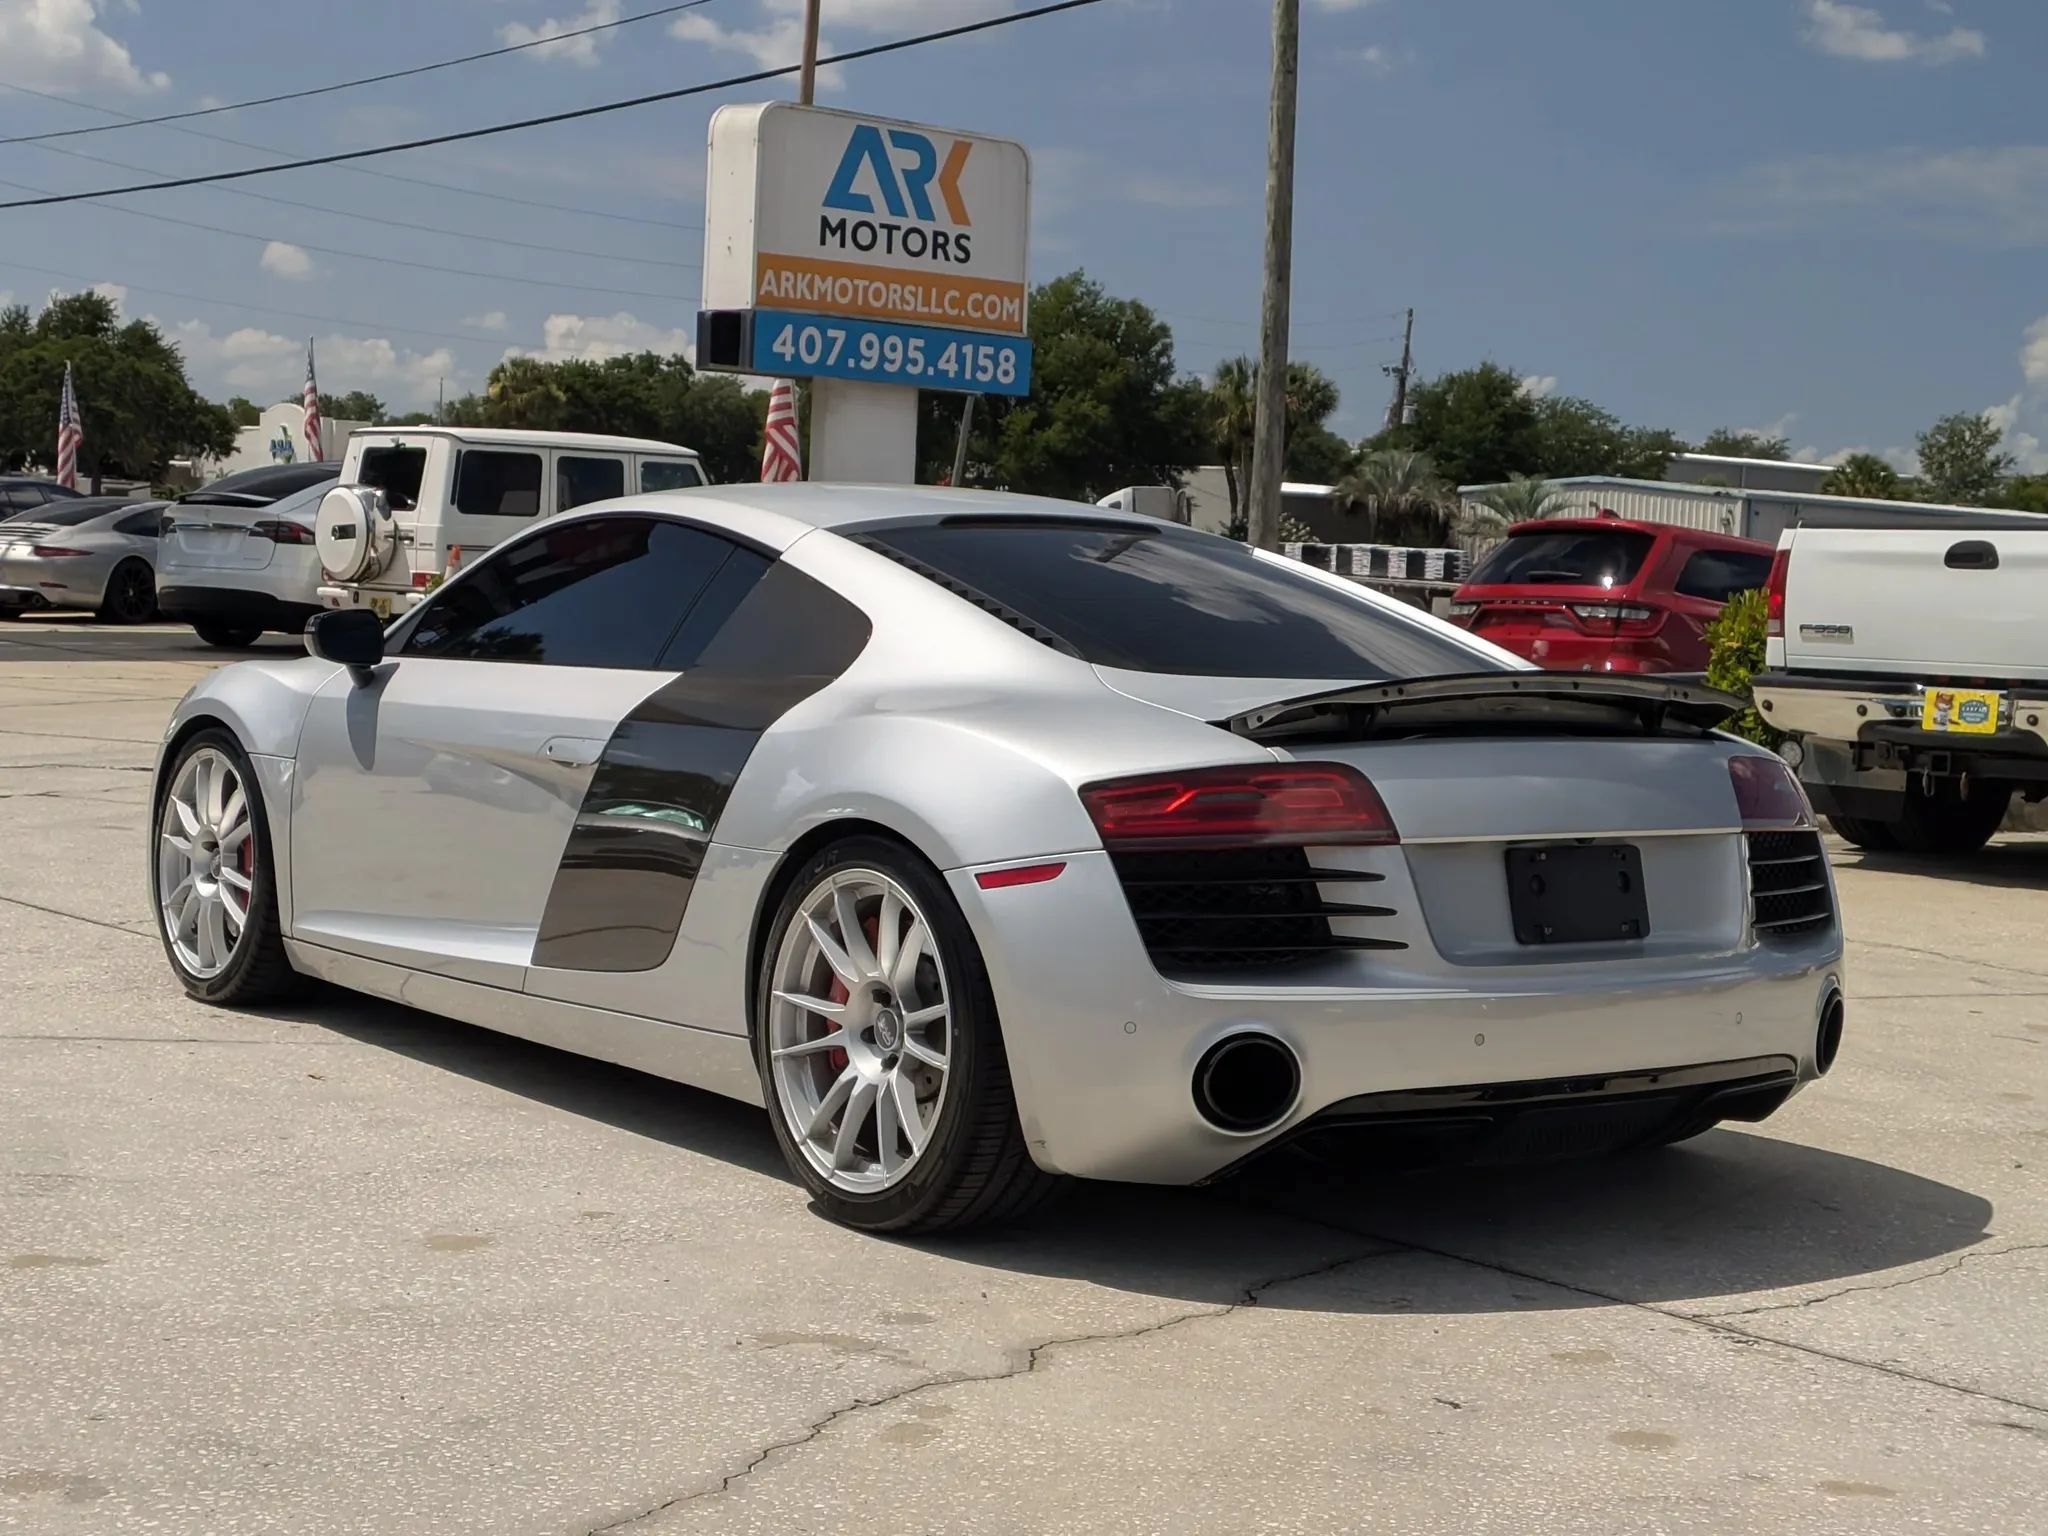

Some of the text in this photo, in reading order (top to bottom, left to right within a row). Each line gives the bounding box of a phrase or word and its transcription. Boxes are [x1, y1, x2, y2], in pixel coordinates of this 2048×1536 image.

[822, 124, 973, 227] ARK
[819, 214, 971, 264] MOTORS
[760, 269, 1020, 322] ARKMOTORSLLC.COM
[772, 323, 1016, 385] 407.995.4158
